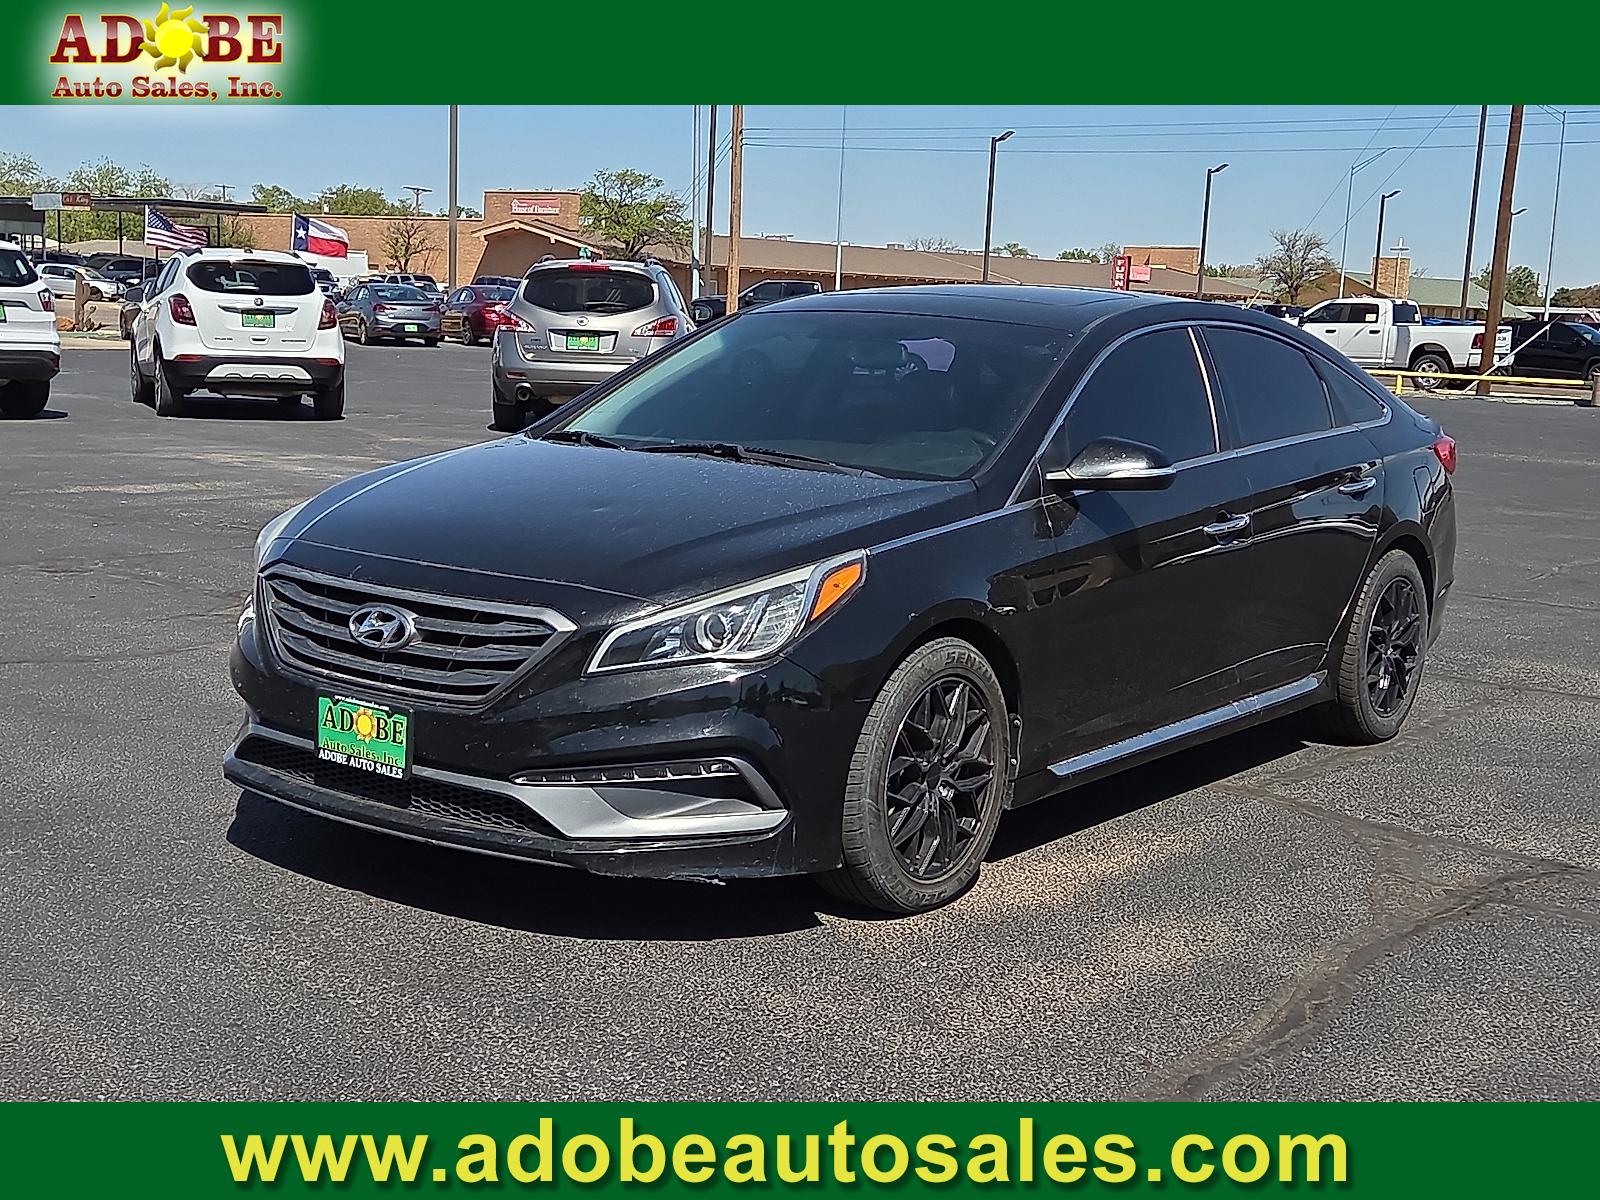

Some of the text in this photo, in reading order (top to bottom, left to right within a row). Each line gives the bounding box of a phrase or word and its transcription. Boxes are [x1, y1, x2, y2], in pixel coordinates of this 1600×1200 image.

[319, 749, 403, 779] ADOBE AUTO SALES
[323, 738, 403, 765] Auto Sales, Inc.
